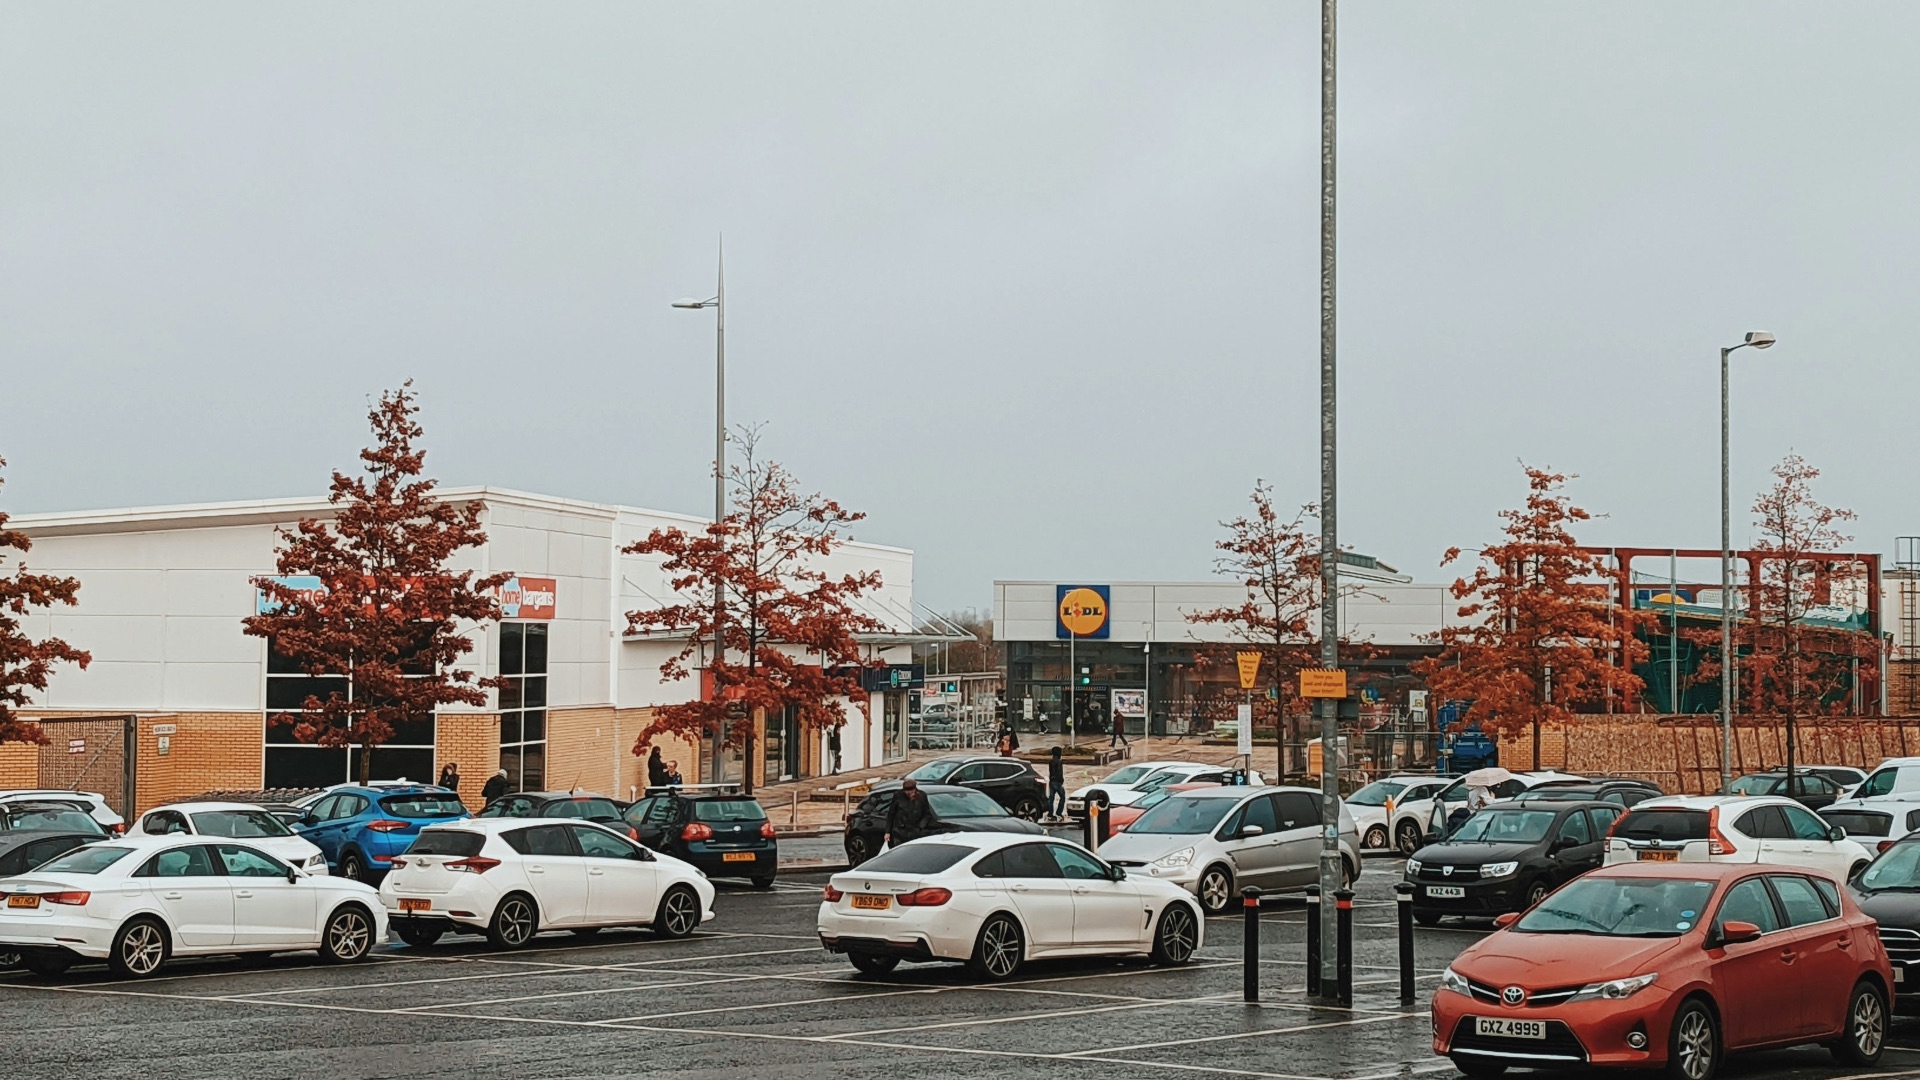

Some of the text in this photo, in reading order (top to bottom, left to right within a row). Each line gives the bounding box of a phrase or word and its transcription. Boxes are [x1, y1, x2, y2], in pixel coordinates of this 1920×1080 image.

[522, 585, 555, 610] bargains
[1062, 602, 1103, 617] LIDL
[1480, 1019, 1540, 1037] GXZ 4999
